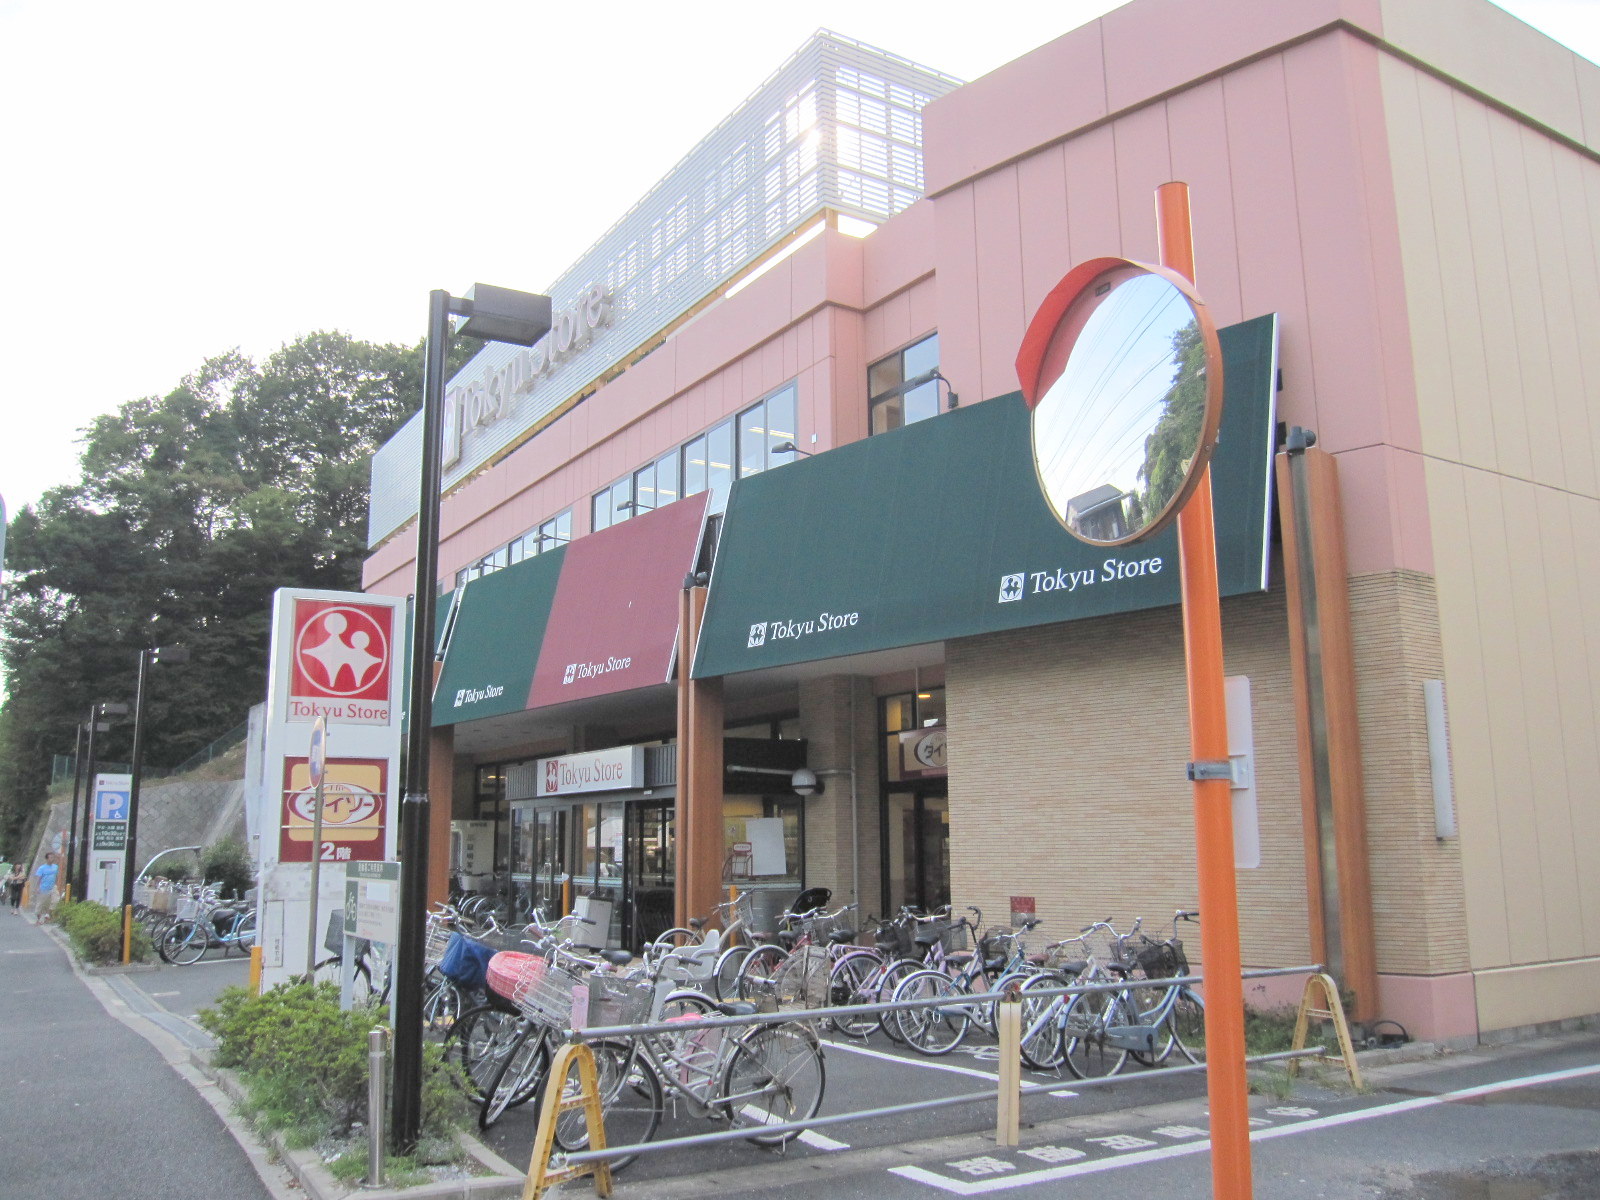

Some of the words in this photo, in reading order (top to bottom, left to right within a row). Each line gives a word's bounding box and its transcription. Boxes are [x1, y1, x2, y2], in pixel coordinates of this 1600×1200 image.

[1030, 567, 1096, 593] Tokyu
[1101, 557, 1162, 583] Store
[770, 619, 815, 640] Tokyu
[817, 612, 859, 632] Store
[577, 661, 604, 679] Tokyu
[605, 656, 632, 673] Store
[464, 688, 485, 704] Tokyu
[484, 684, 504, 699] Store
[291, 701, 343, 718] Tokyu
[346, 703, 388, 720] Store
[560, 762, 591, 788] Tokyu
[593, 758, 623, 783] Store
[320, 841, 352, 860] 2階
